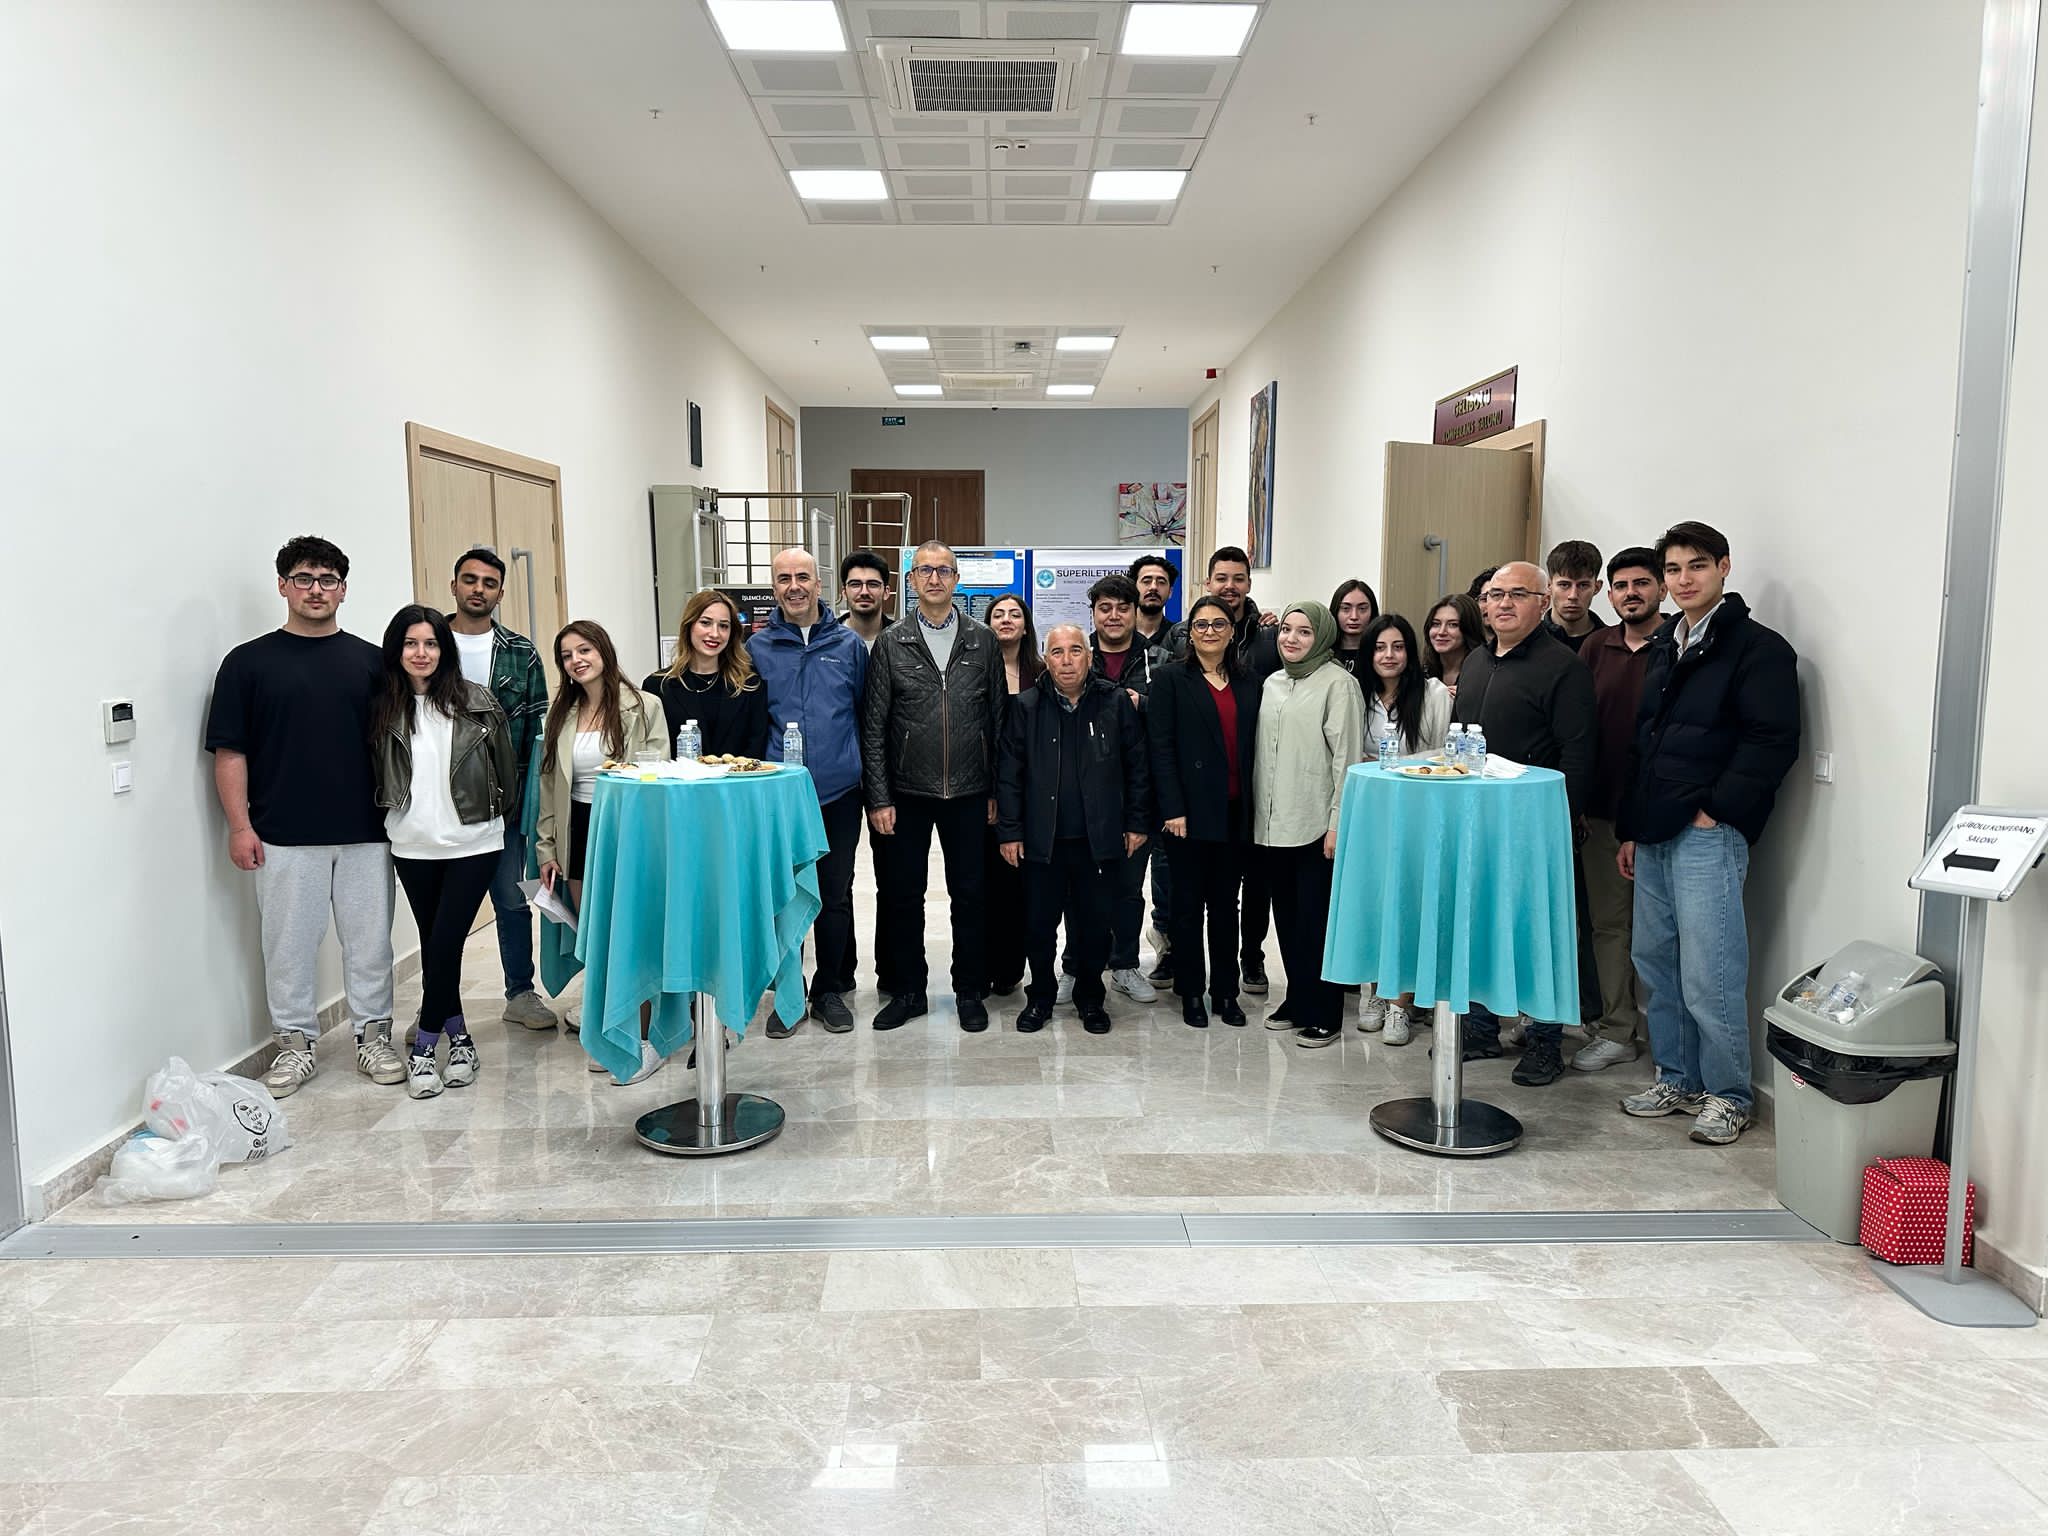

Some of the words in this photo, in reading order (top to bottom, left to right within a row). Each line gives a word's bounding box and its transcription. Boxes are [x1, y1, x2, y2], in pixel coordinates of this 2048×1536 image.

[1442, 421, 1476, 443] KONFERANS
[1479, 409, 1504, 431] SALONU
[1967, 834, 1998, 844] SALONU
